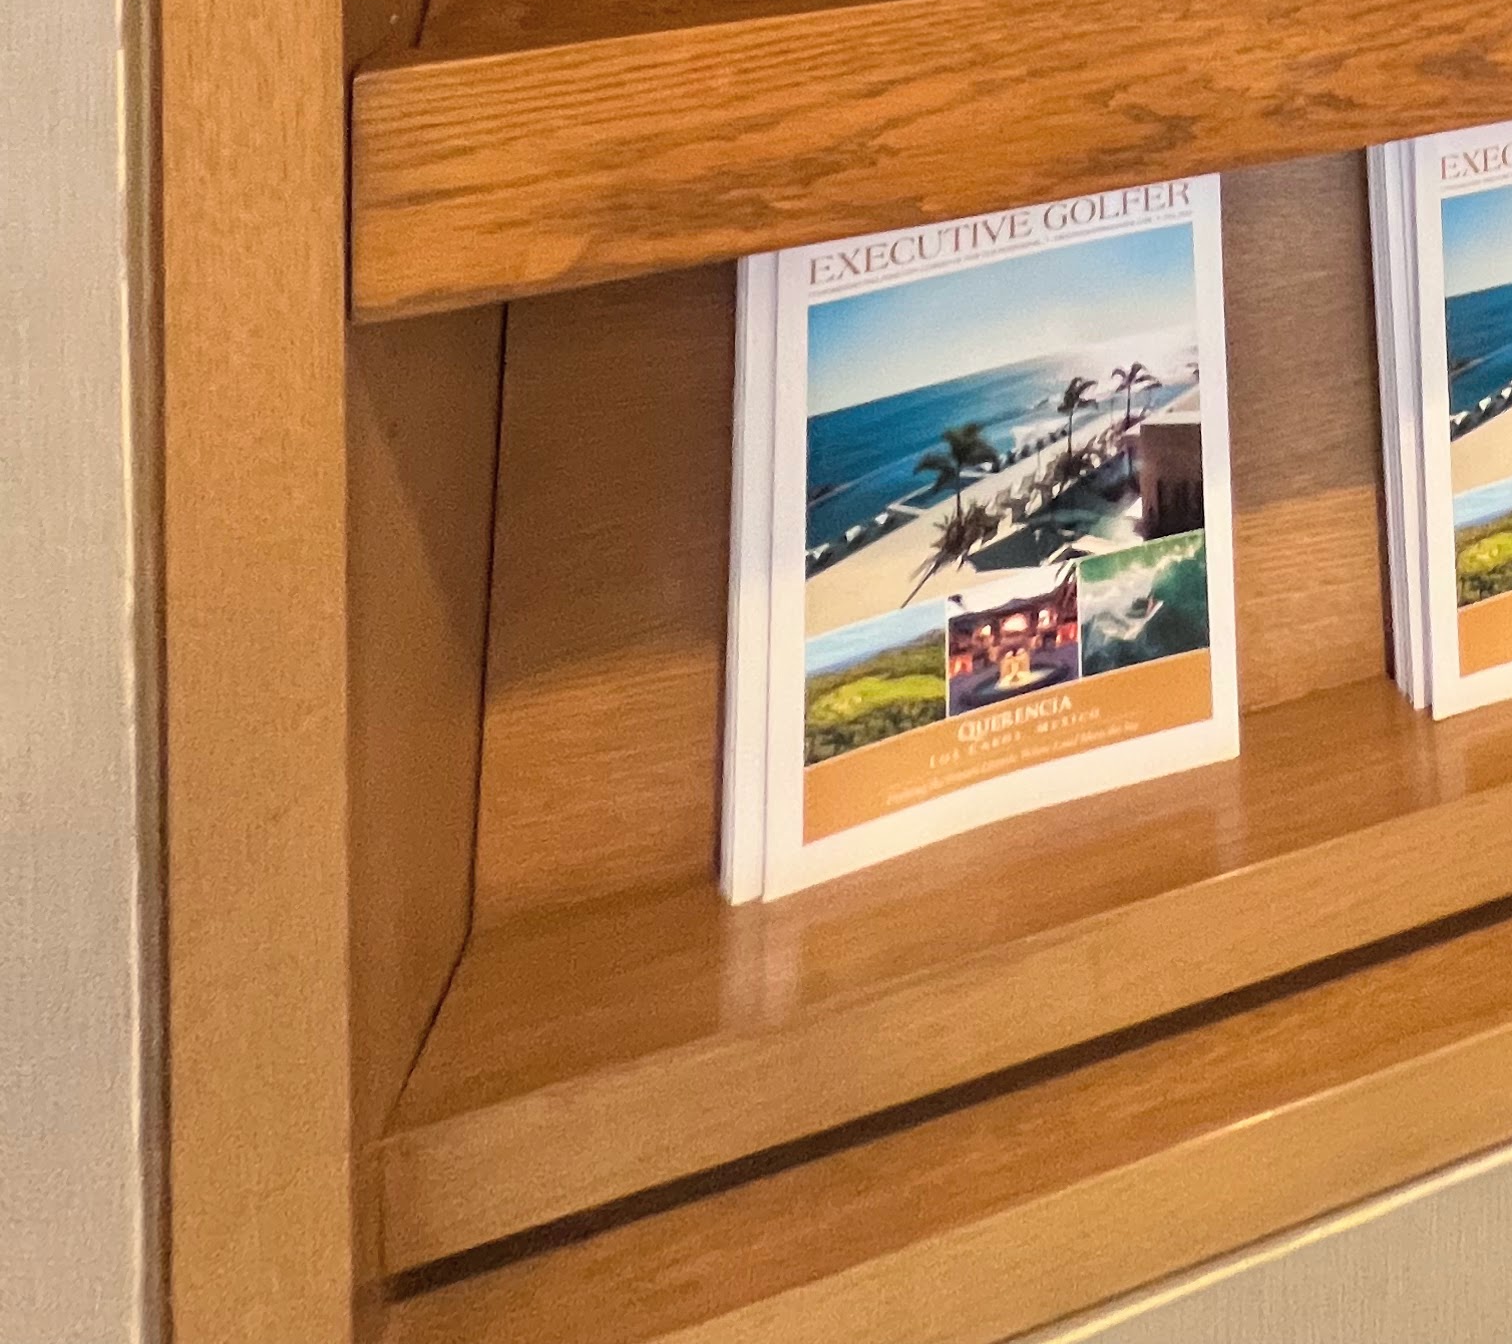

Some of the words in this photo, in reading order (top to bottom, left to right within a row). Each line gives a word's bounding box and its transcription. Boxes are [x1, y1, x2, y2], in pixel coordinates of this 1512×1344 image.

[809, 209, 1032, 286] EXECUTIVE
[1043, 181, 1191, 232] GOLFER
[957, 693, 1073, 743] QUERENCIA
